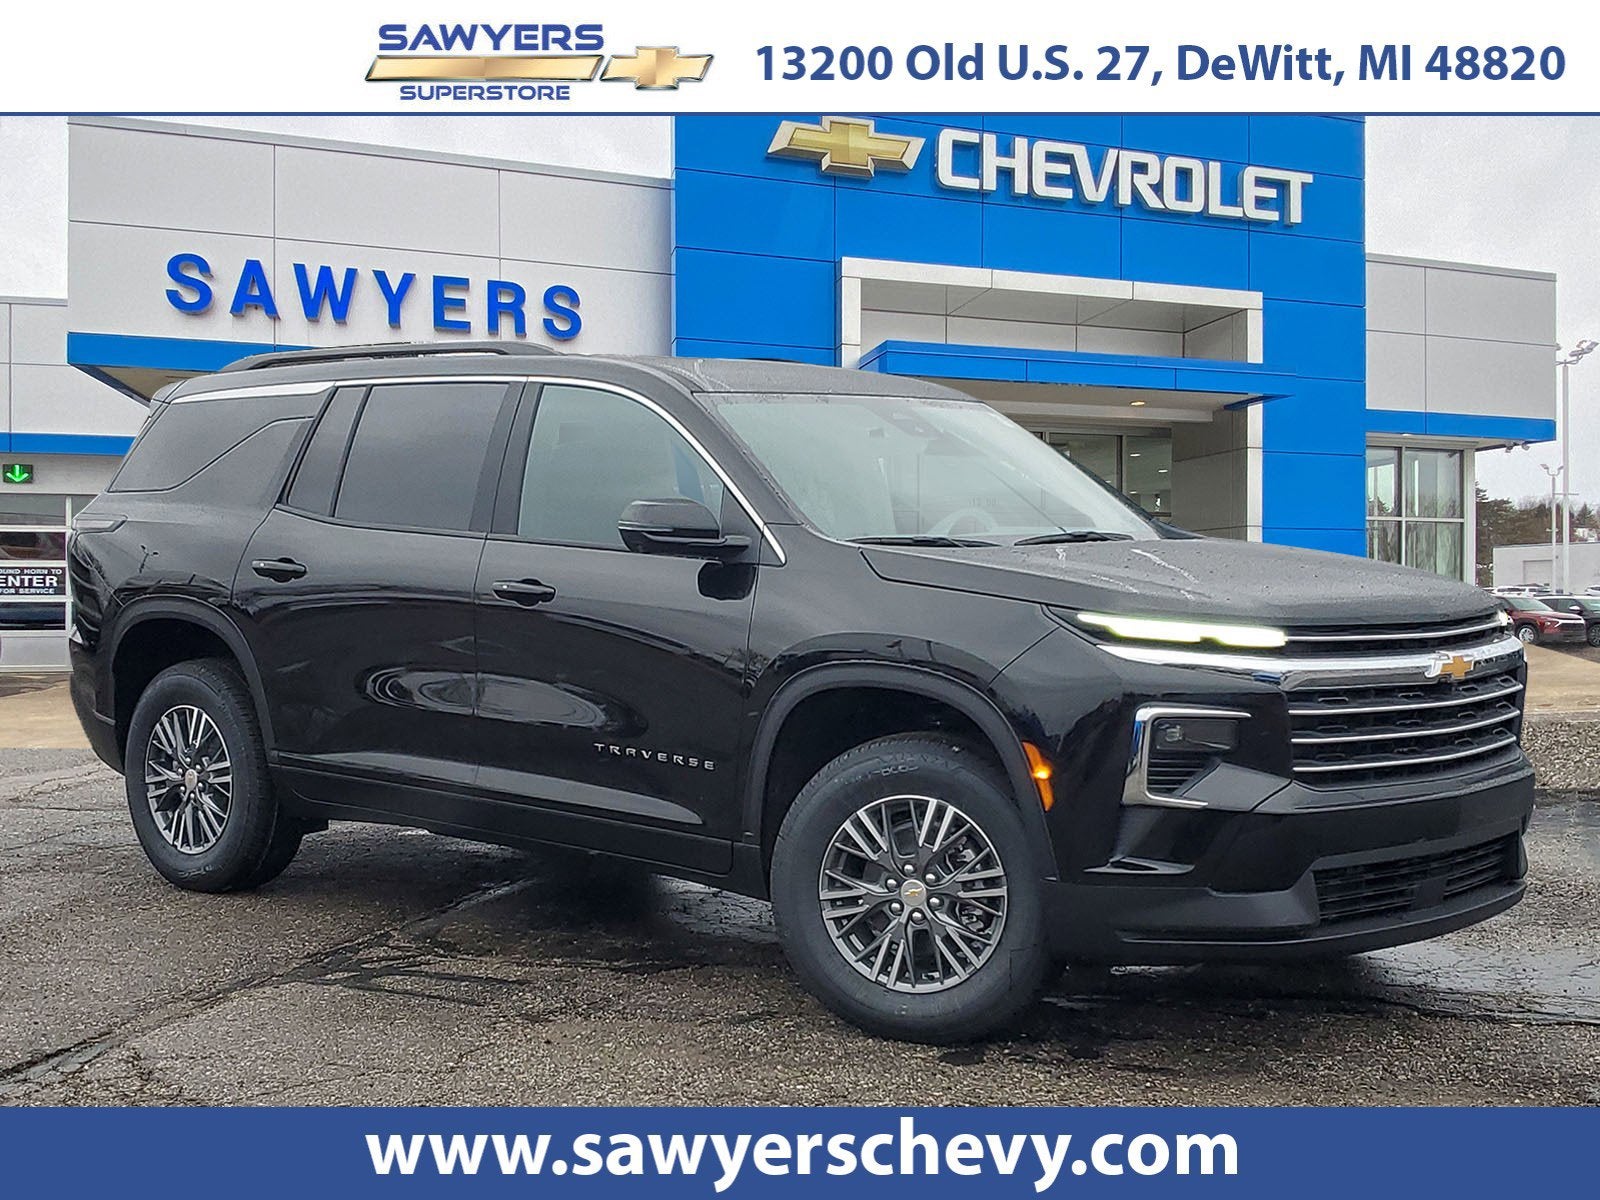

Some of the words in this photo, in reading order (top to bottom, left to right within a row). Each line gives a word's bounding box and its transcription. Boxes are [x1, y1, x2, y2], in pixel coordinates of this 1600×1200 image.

[936, 128, 1313, 225] CHEVROLET
[165, 253, 582, 341] SAWYERS
[0, 575, 58, 587] ENTER
[593, 742, 715, 771] TRAVERSE
